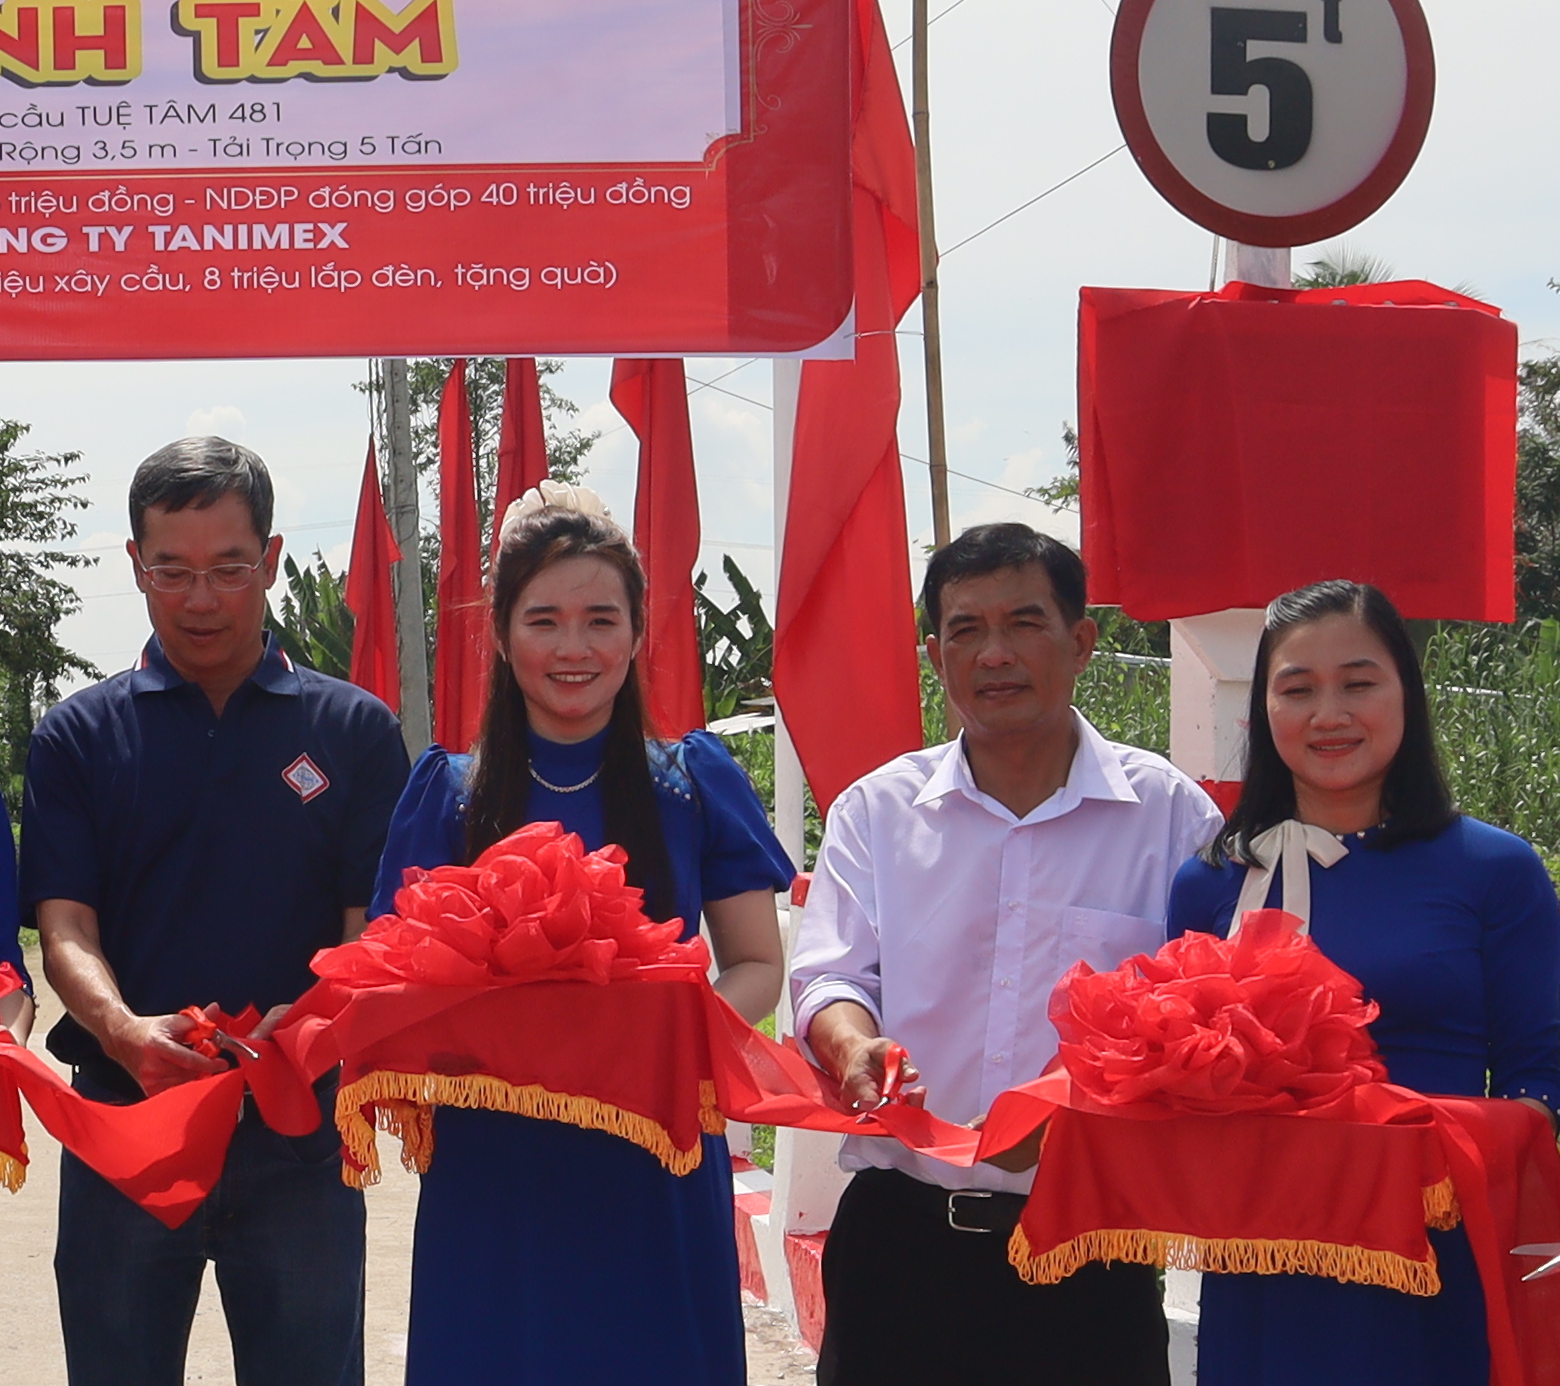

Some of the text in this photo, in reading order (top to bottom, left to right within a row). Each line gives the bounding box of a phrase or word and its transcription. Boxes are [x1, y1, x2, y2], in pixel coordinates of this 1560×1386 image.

[76, 101, 132, 132] TUỆ
[143, 100, 217, 125] TÂM
[228, 101, 282, 123] 481
[92, 140, 138, 162] 3,5
[148, 144, 177, 159] m
[209, 136, 251, 158] Tải
[260, 139, 349, 162] Trọng
[358, 136, 375, 157] 5
[386, 133, 442, 157] Tấn
[8, 189, 77, 217] triệu
[88, 184, 175, 216] đồng
[206, 187, 299, 210] NDĐP
[309, 186, 394, 213] đóng
[406, 184, 471, 212] góp
[481, 184, 517, 205] 40
[527, 182, 595, 209] triệu
[606, 177, 691, 208] đồng
[82, 226, 134, 252] TY
[148, 222, 349, 251] TANIMEX
[55, 269, 110, 295] xây
[121, 262, 191, 292] cầu,
[203, 267, 221, 290] 8
[231, 265, 300, 292] triệu
[310, 261, 362, 294] lắp
[372, 264, 442, 290] đèn,
[454, 262, 530, 291] tặng
[541, 260, 618, 290] quà)
